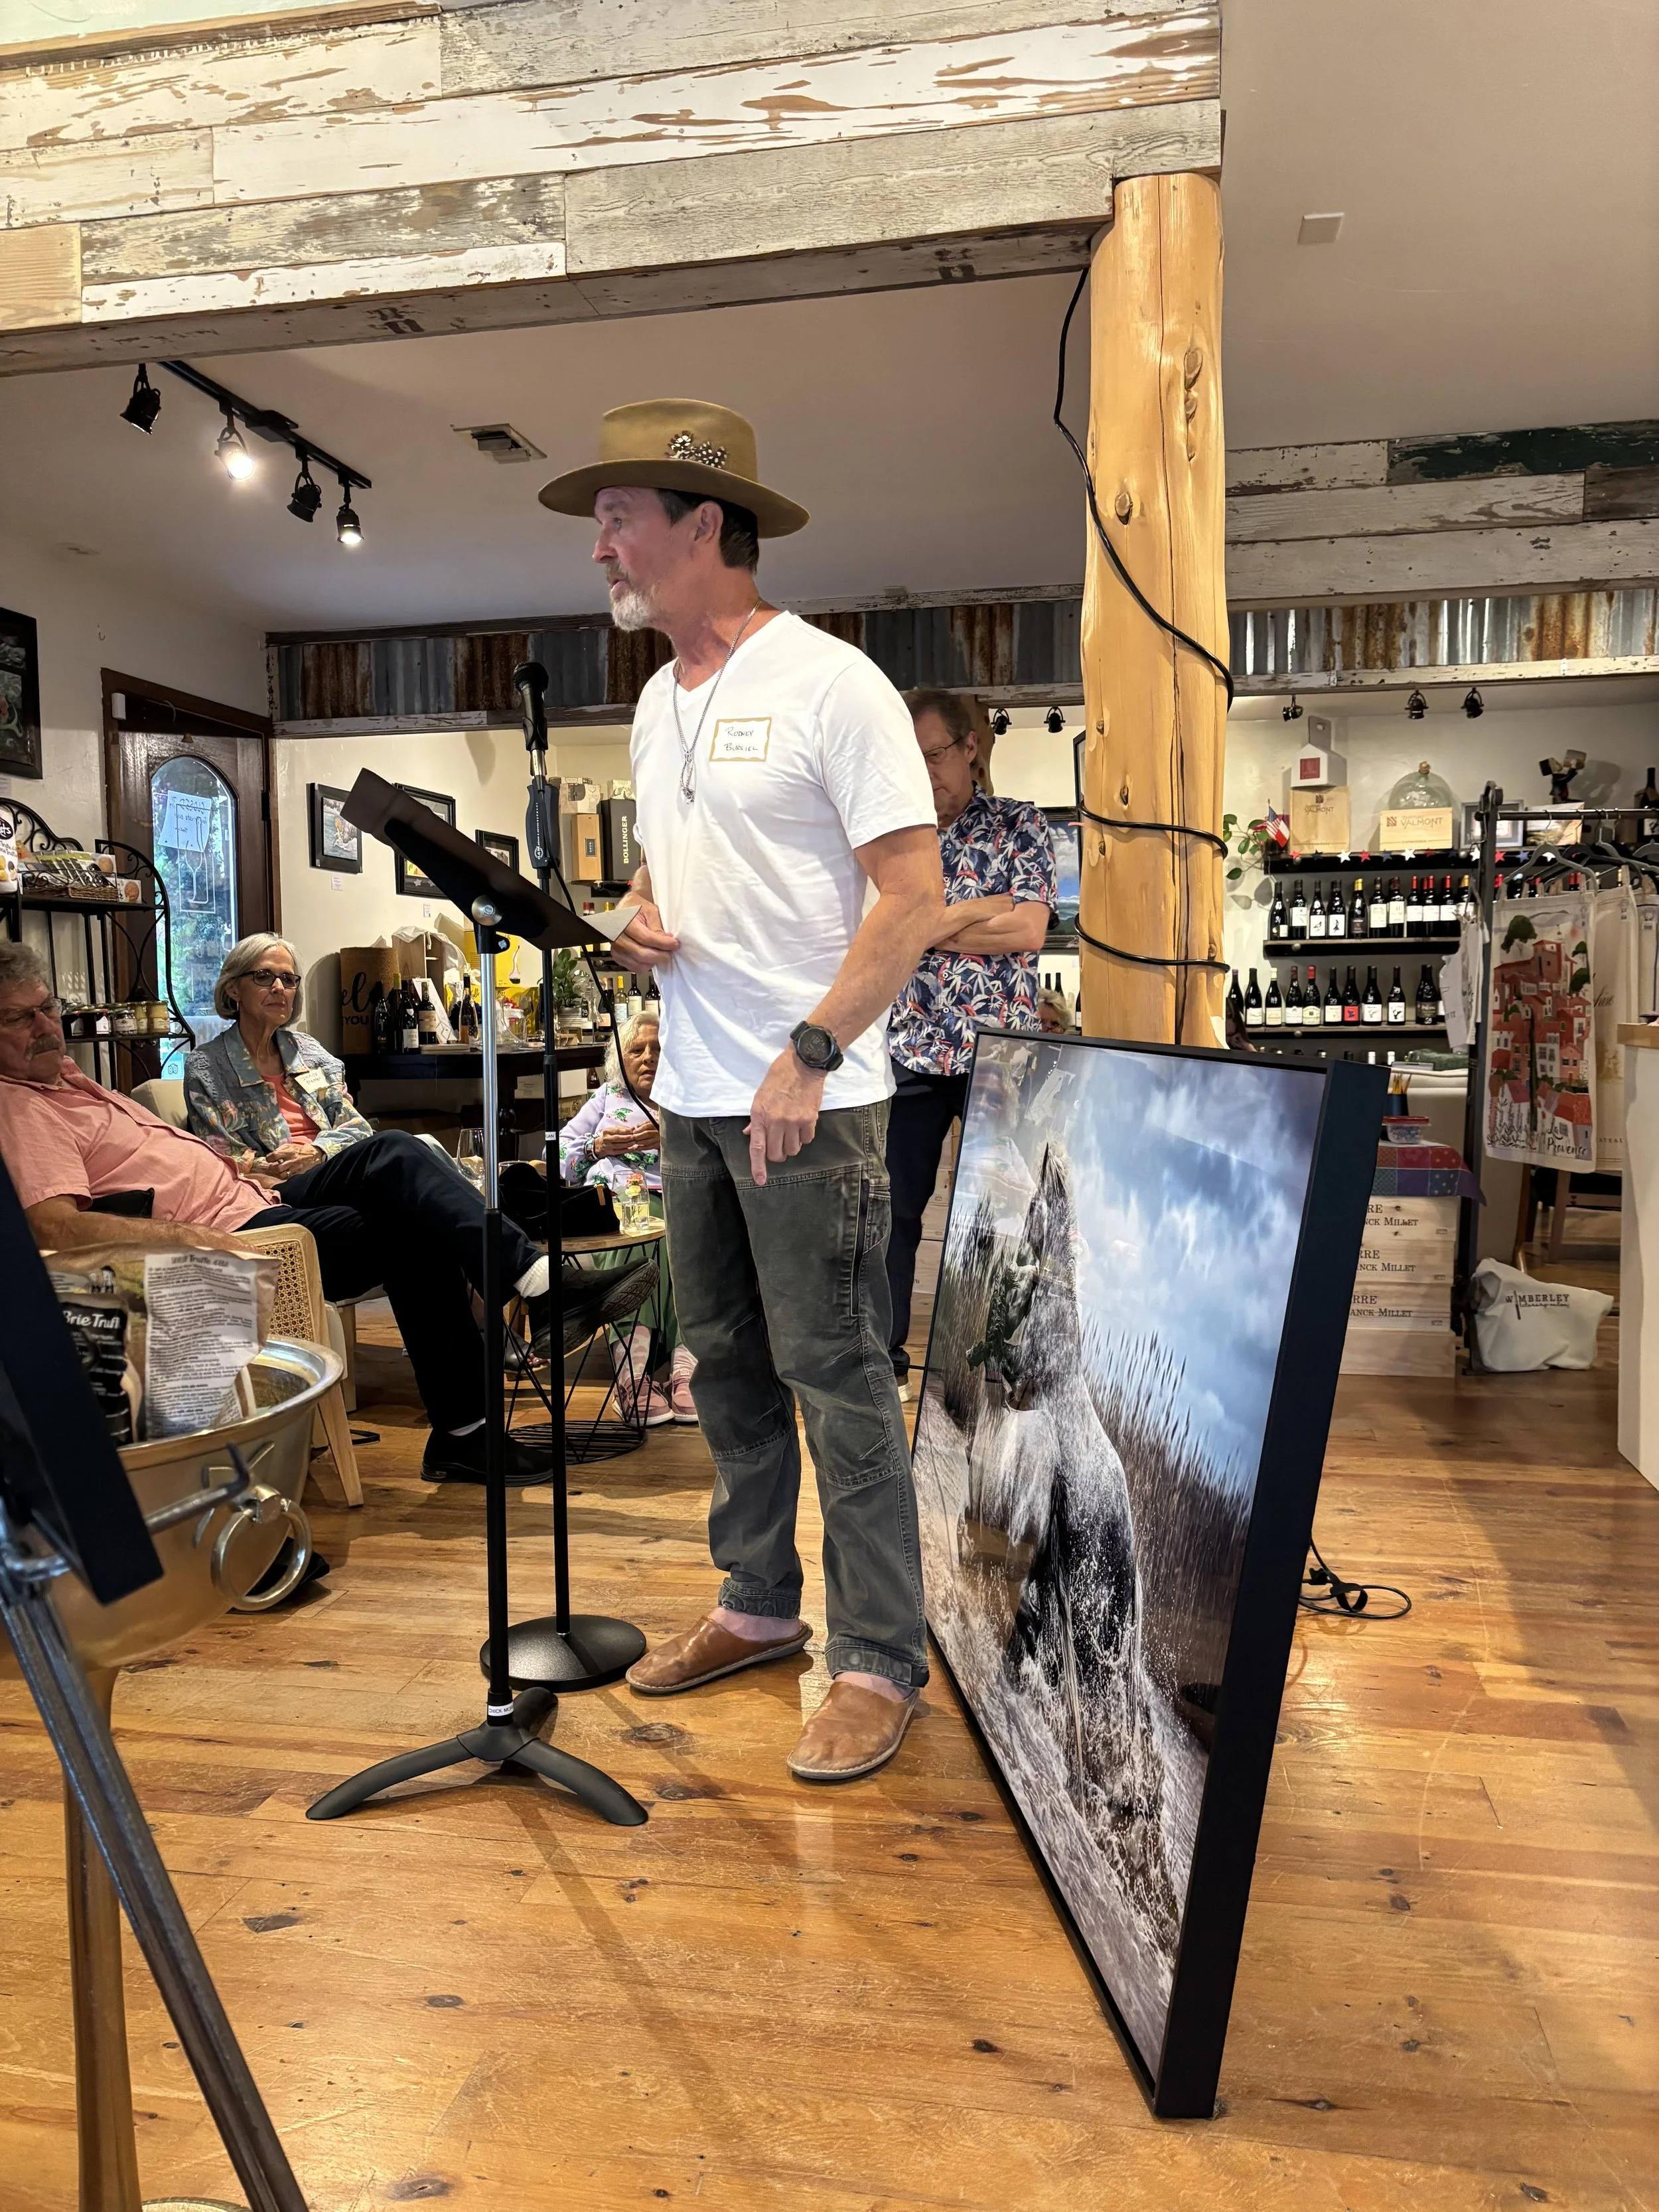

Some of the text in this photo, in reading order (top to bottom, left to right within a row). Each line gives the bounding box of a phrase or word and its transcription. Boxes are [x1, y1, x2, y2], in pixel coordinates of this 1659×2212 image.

[1305, 806, 1334, 815] VALMONT
[1400, 817, 1443, 830] VALMONT
[344, 1015, 369, 1025] YOU
[1547, 1137, 1586, 1155] Provence
[1381, 1262, 1416, 1272] MILLET
[1352, 1295, 1378, 1305] RRE
[1378, 1307, 1413, 1317] MILLET
